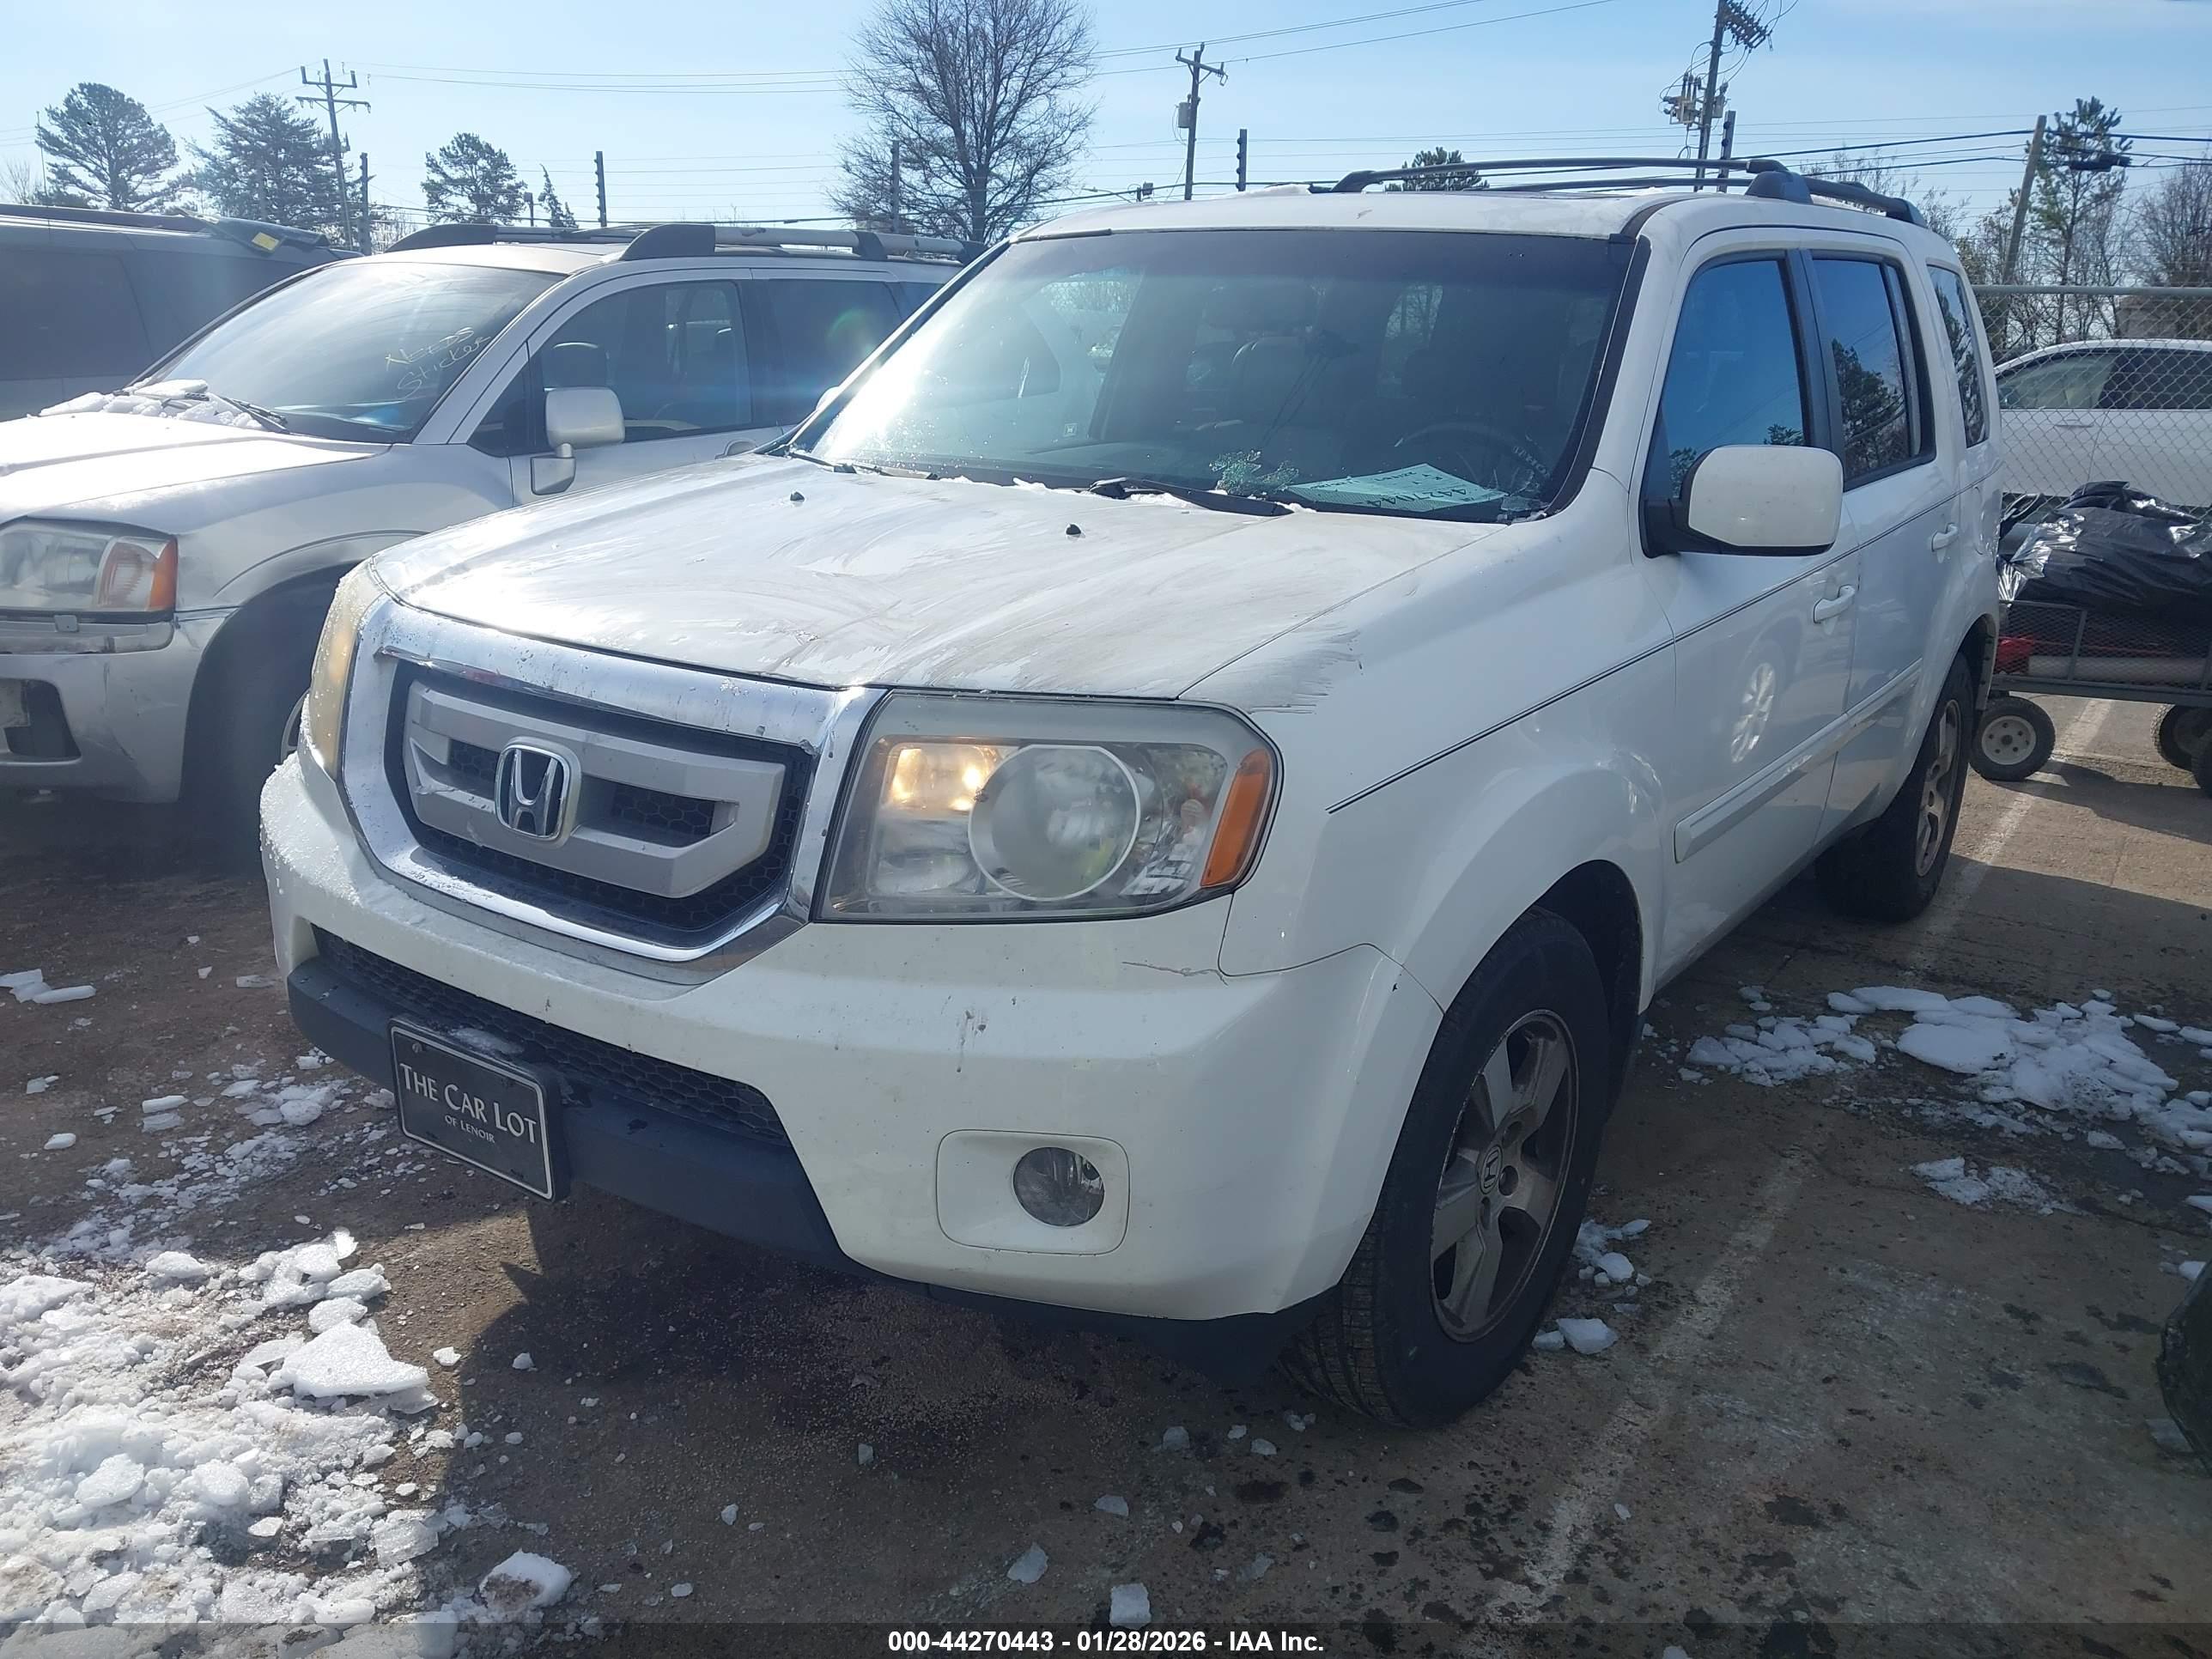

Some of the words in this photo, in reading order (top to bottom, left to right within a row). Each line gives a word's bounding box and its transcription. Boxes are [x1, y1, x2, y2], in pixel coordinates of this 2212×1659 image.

[386, 327, 474, 371] NEEDS
[399, 1063, 439, 1102] THE
[444, 1084, 487, 1122] CAR
[494, 1102, 536, 1144] LOT
[445, 1115, 459, 1127] OF
[460, 1120, 495, 1144] LENOIR
